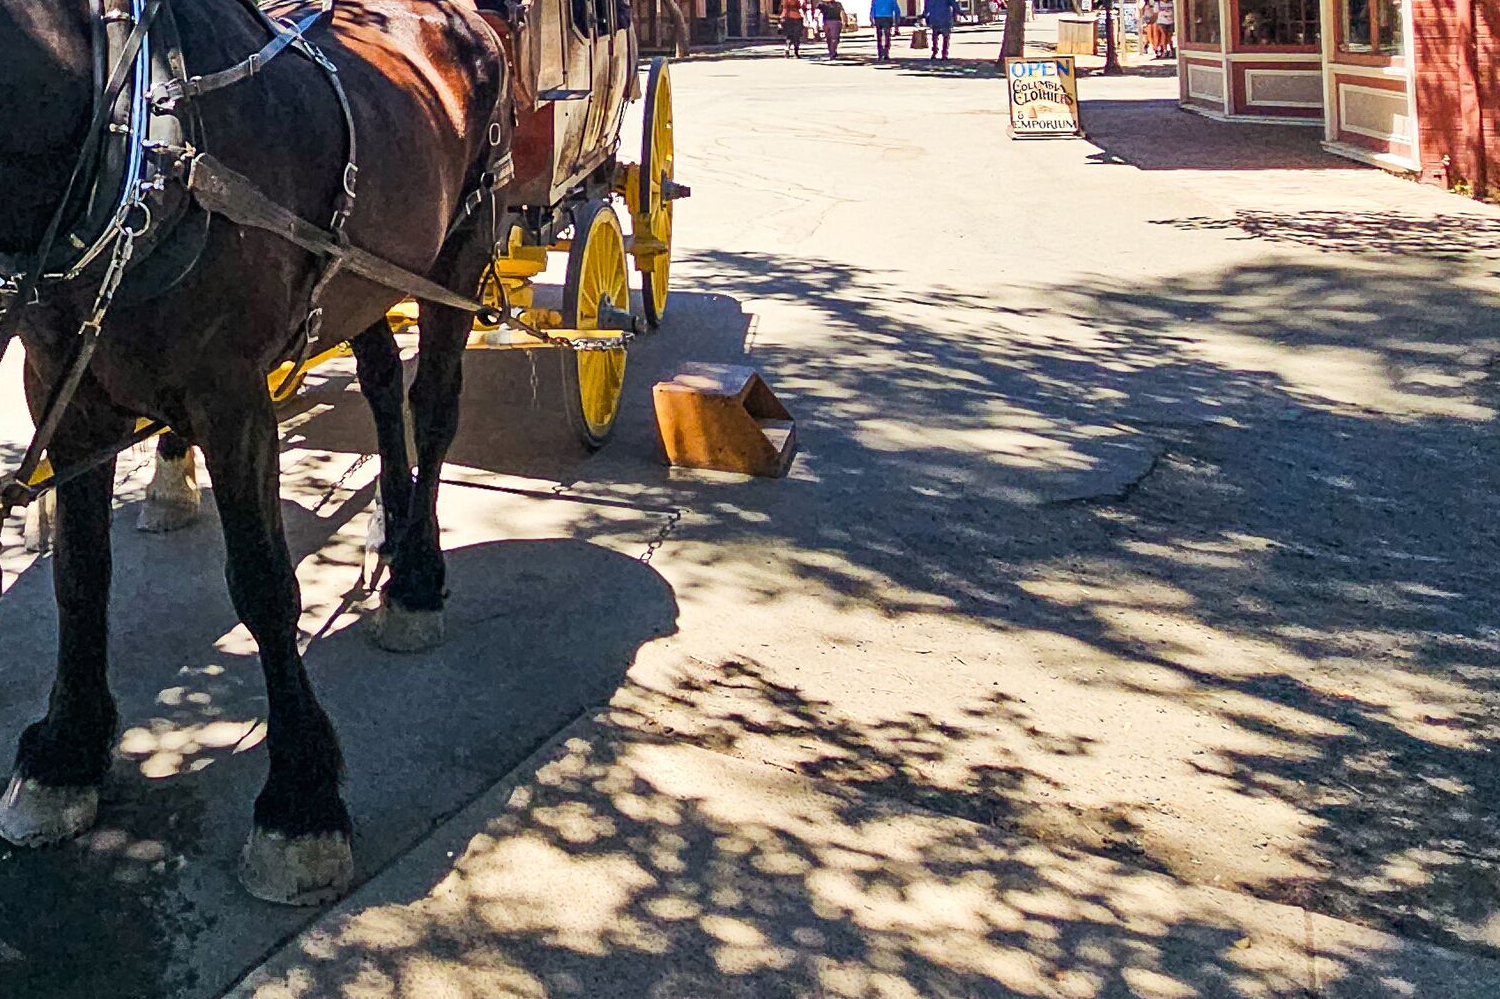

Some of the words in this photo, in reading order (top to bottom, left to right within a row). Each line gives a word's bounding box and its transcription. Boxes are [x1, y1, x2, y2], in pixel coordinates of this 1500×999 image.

[1011, 60, 1071, 77] OPEN
[1013, 79, 1067, 94] COLUMBIA
[1013, 88, 1074, 106] CLOTHIERS
[1013, 120, 1078, 130] EMPORIUM
